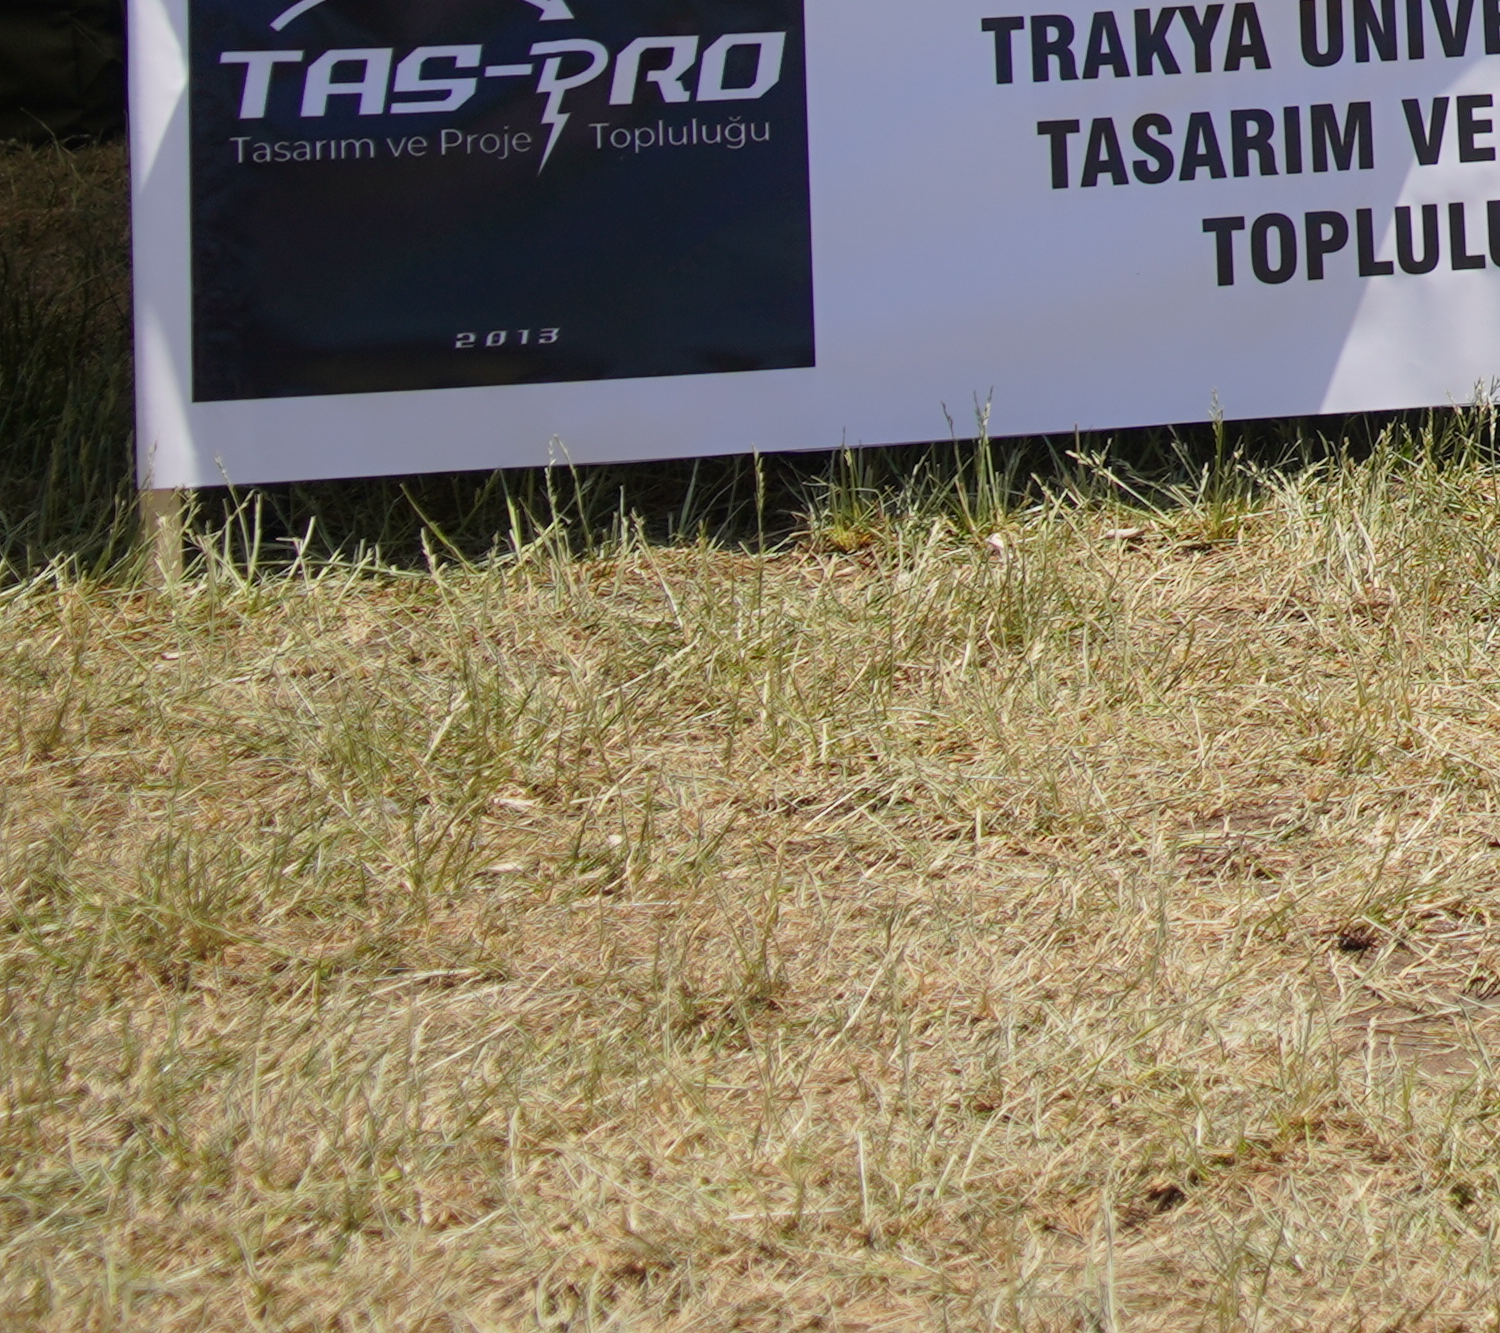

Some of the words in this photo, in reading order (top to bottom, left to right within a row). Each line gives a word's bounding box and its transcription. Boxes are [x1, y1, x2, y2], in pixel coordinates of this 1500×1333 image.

[981, 1, 1273, 85] TRAKYA
[220, 31, 787, 153] TAS-PRO
[229, 135, 376, 164] Tasarım
[392, 137, 429, 158] ve
[440, 126, 533, 161] Proje
[588, 115, 771, 151] Topluluğu
[1036, 99, 1376, 190] TASARIM
[1401, 94, 1497, 166] VE
[454, 327, 561, 349] 2013
